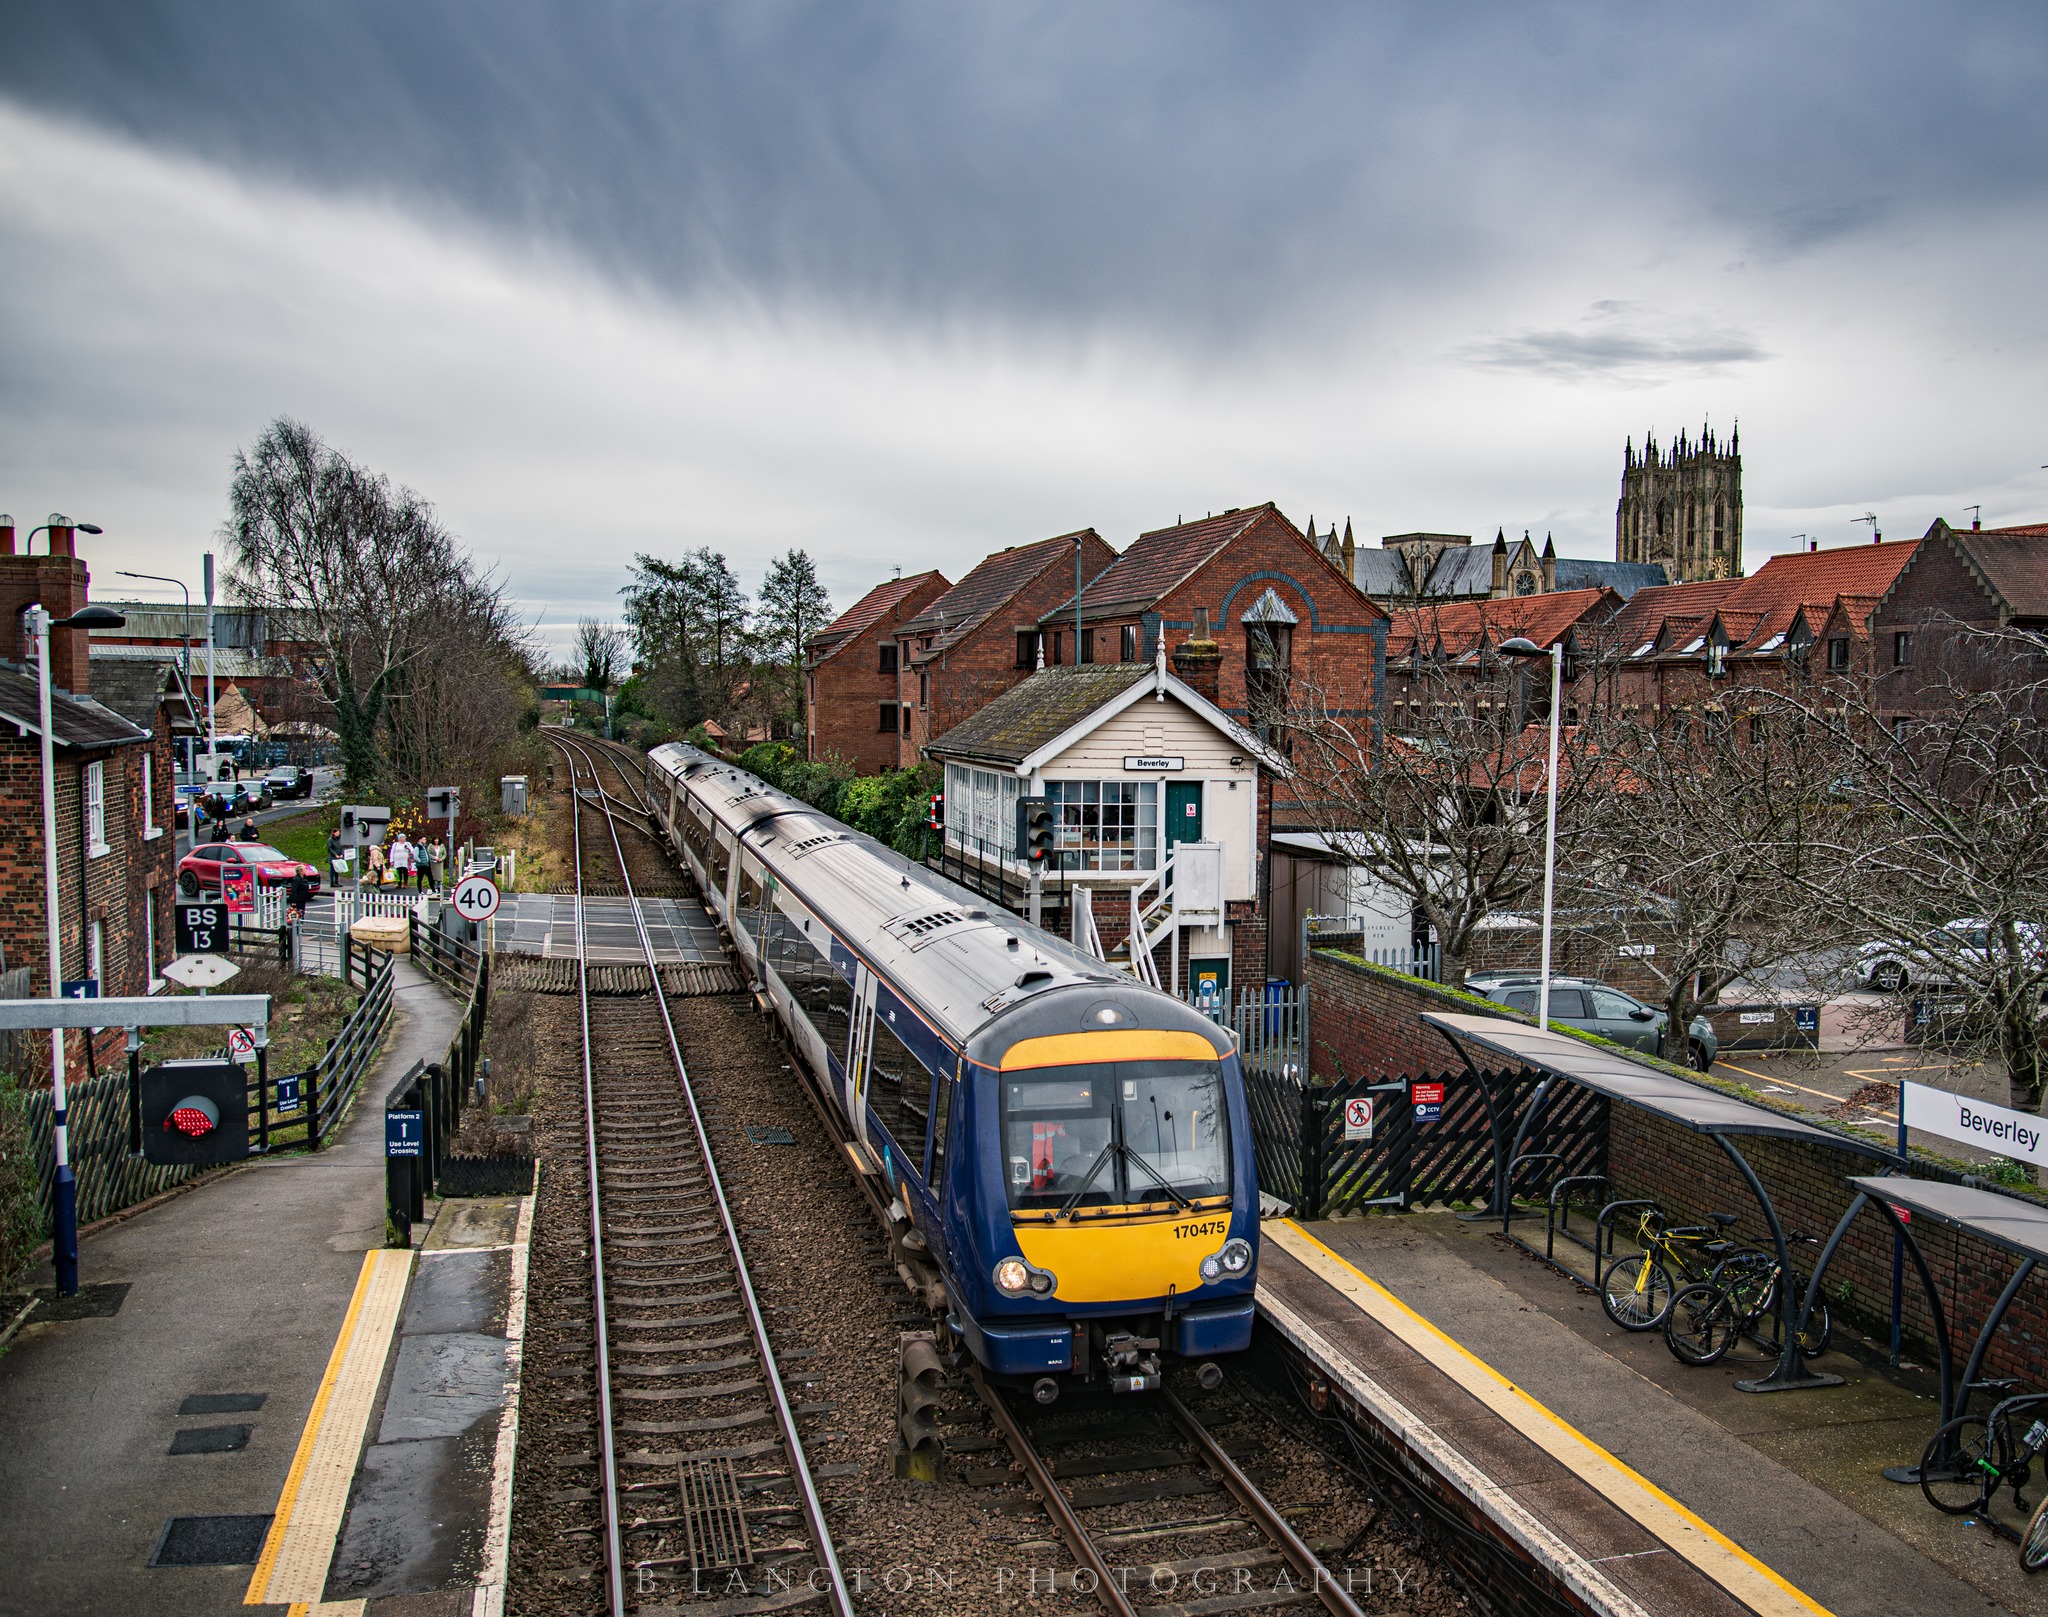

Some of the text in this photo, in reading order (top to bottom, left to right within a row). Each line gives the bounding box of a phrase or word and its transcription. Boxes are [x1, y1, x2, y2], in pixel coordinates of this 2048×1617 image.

[1138, 760, 1169, 768] Beverley
[460, 888, 492, 908] 40
[187, 908, 217, 925] BS
[194, 931, 211, 948] 13
[74, 986, 85, 998] 1
[1961, 1107, 2040, 1152] Beverley
[1174, 1221, 1225, 1238] 170475
